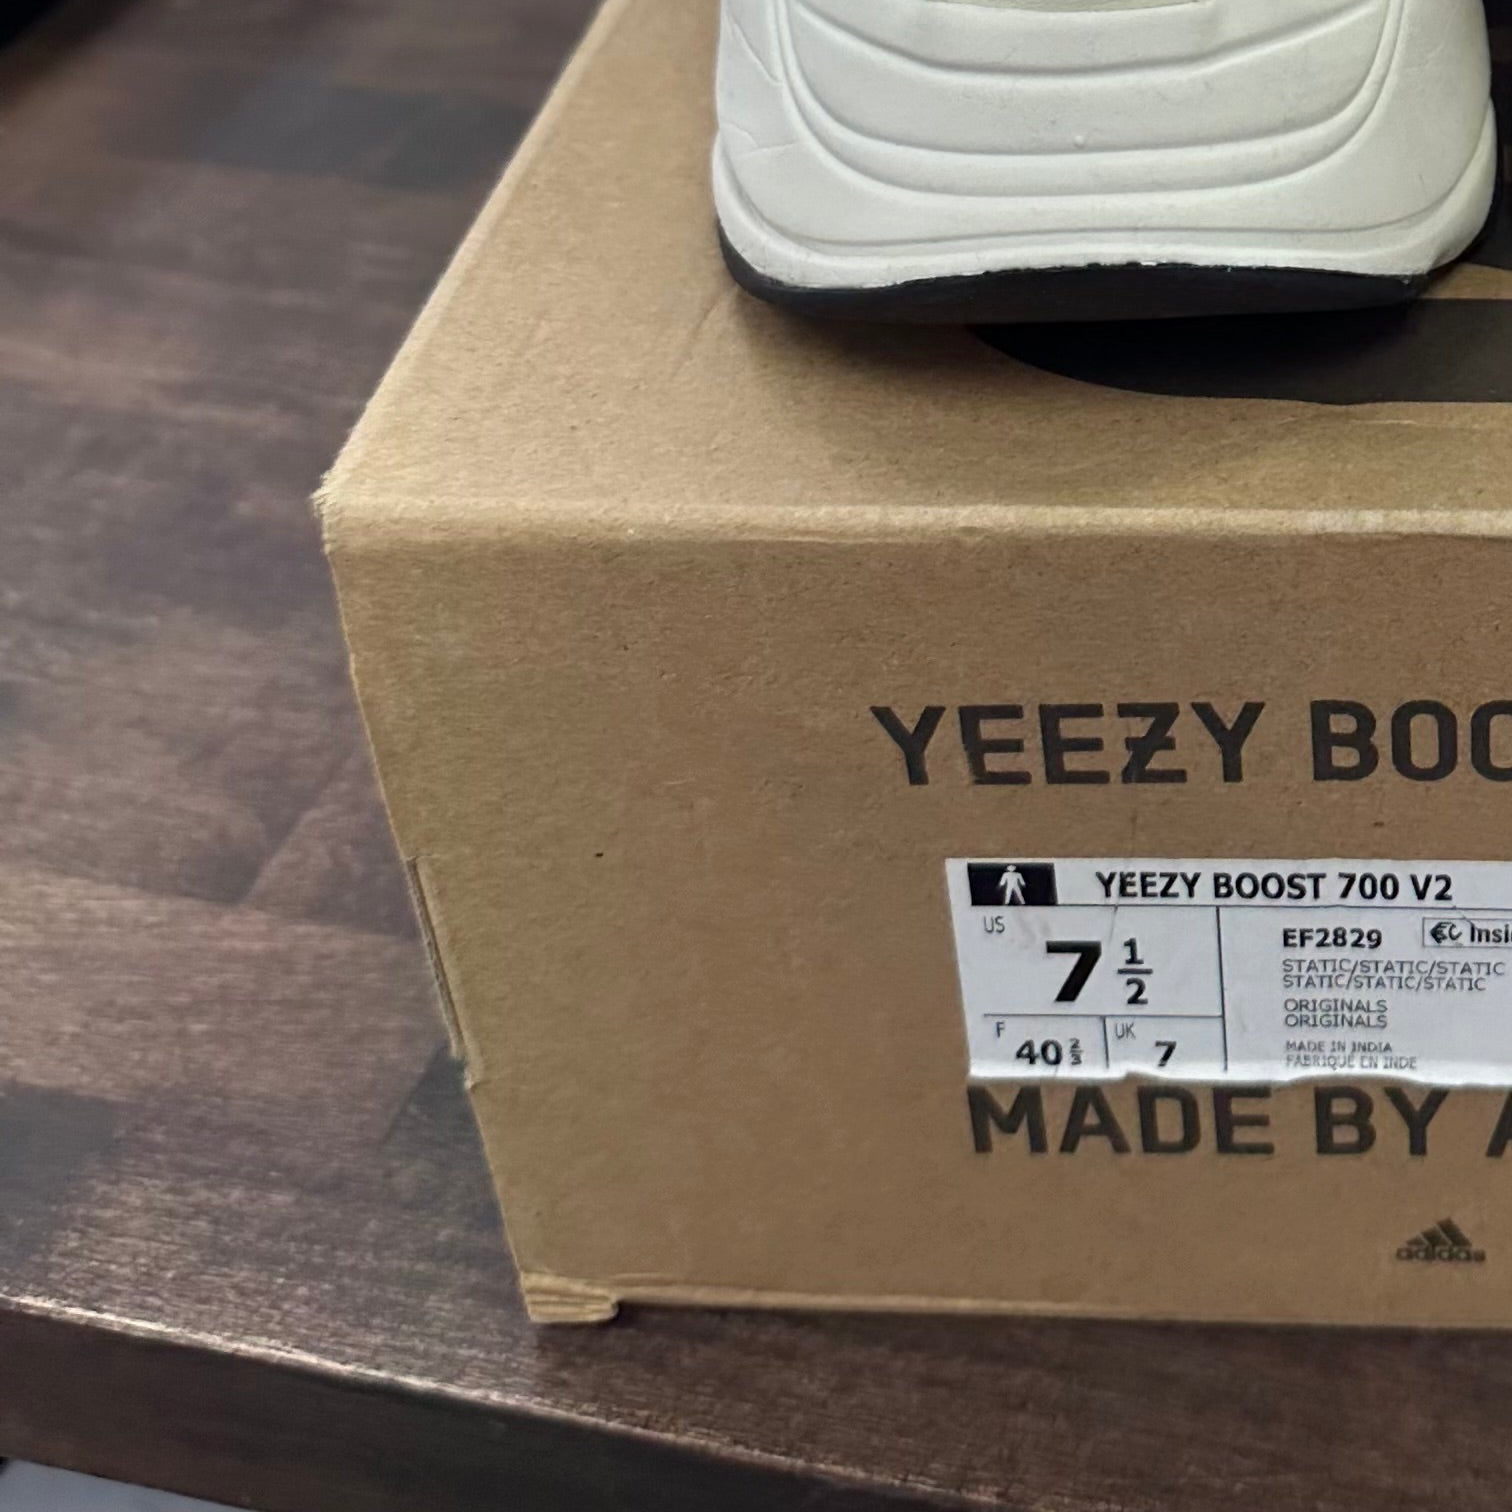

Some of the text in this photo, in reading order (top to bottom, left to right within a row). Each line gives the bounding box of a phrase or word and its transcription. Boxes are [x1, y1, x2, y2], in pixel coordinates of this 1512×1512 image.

[870, 701, 1265, 786] YEEZY
[1095, 871, 1454, 901] YEEZY BOOST 700 V2
[983, 915, 1006, 934] US
[1282, 927, 1384, 949] EF2829
[1046, 940, 1103, 1003] 7
[1282, 958, 1506, 976] STATIC/STATIC/STATIC
[1282, 974, 1487, 992] STATIC/STATIC/STATIC
[1283, 998, 1388, 1014] ORIGINALS
[995, 1021, 1006, 1037] F
[1284, 1014, 1388, 1029] ORIGINALS
[1114, 1023, 1136, 1039] UK
[1015, 1039, 1063, 1066] 40
[1154, 1040, 1177, 1067] 7
[1285, 1040, 1393, 1053] MADE IN INDIA
[967, 1085, 1275, 1155] MADE
[1314, 1086, 1450, 1156] BY
[1396, 1245, 1486, 1262] adidas
